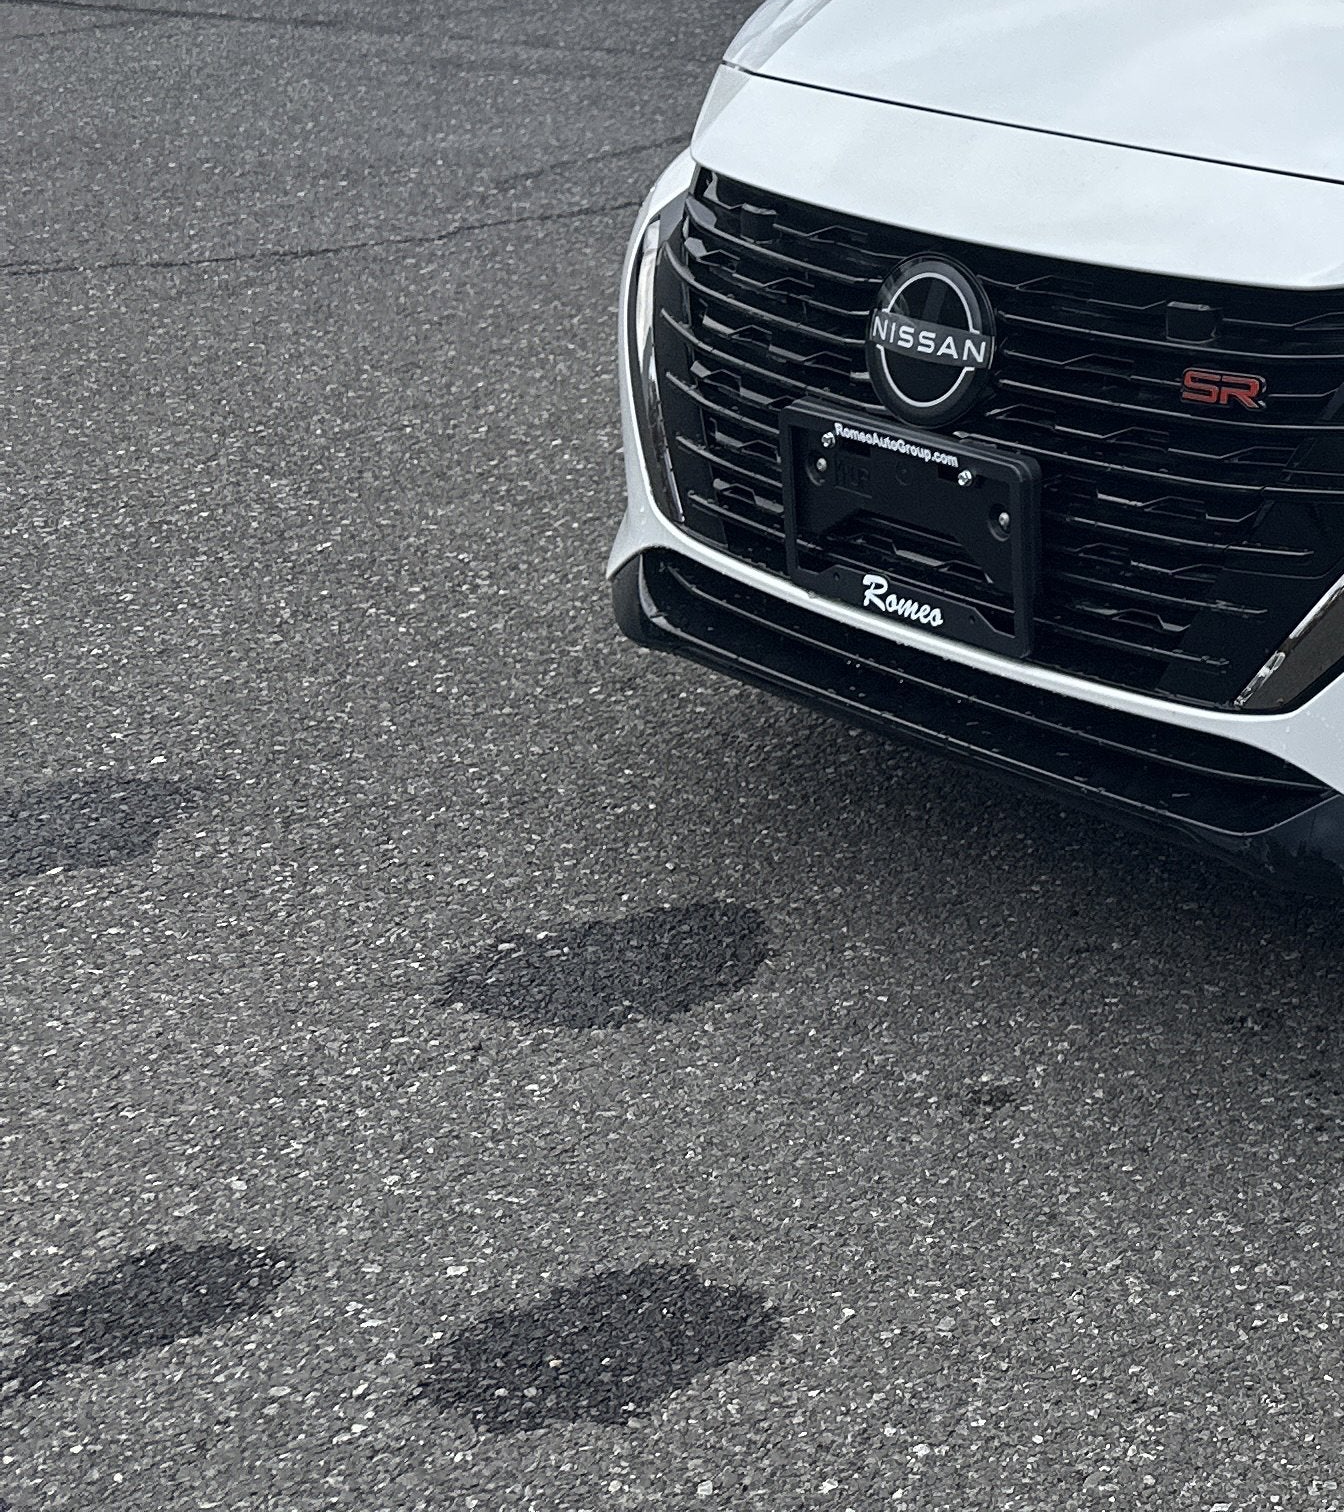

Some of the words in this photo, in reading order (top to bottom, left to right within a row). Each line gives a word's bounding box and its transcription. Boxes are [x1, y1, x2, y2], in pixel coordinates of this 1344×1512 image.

[872, 316, 987, 363] NISSAN
[1181, 368, 1266, 410] SR
[834, 422, 959, 468] RomeoAutoGroup.com
[862, 574, 944, 627] Romeo
